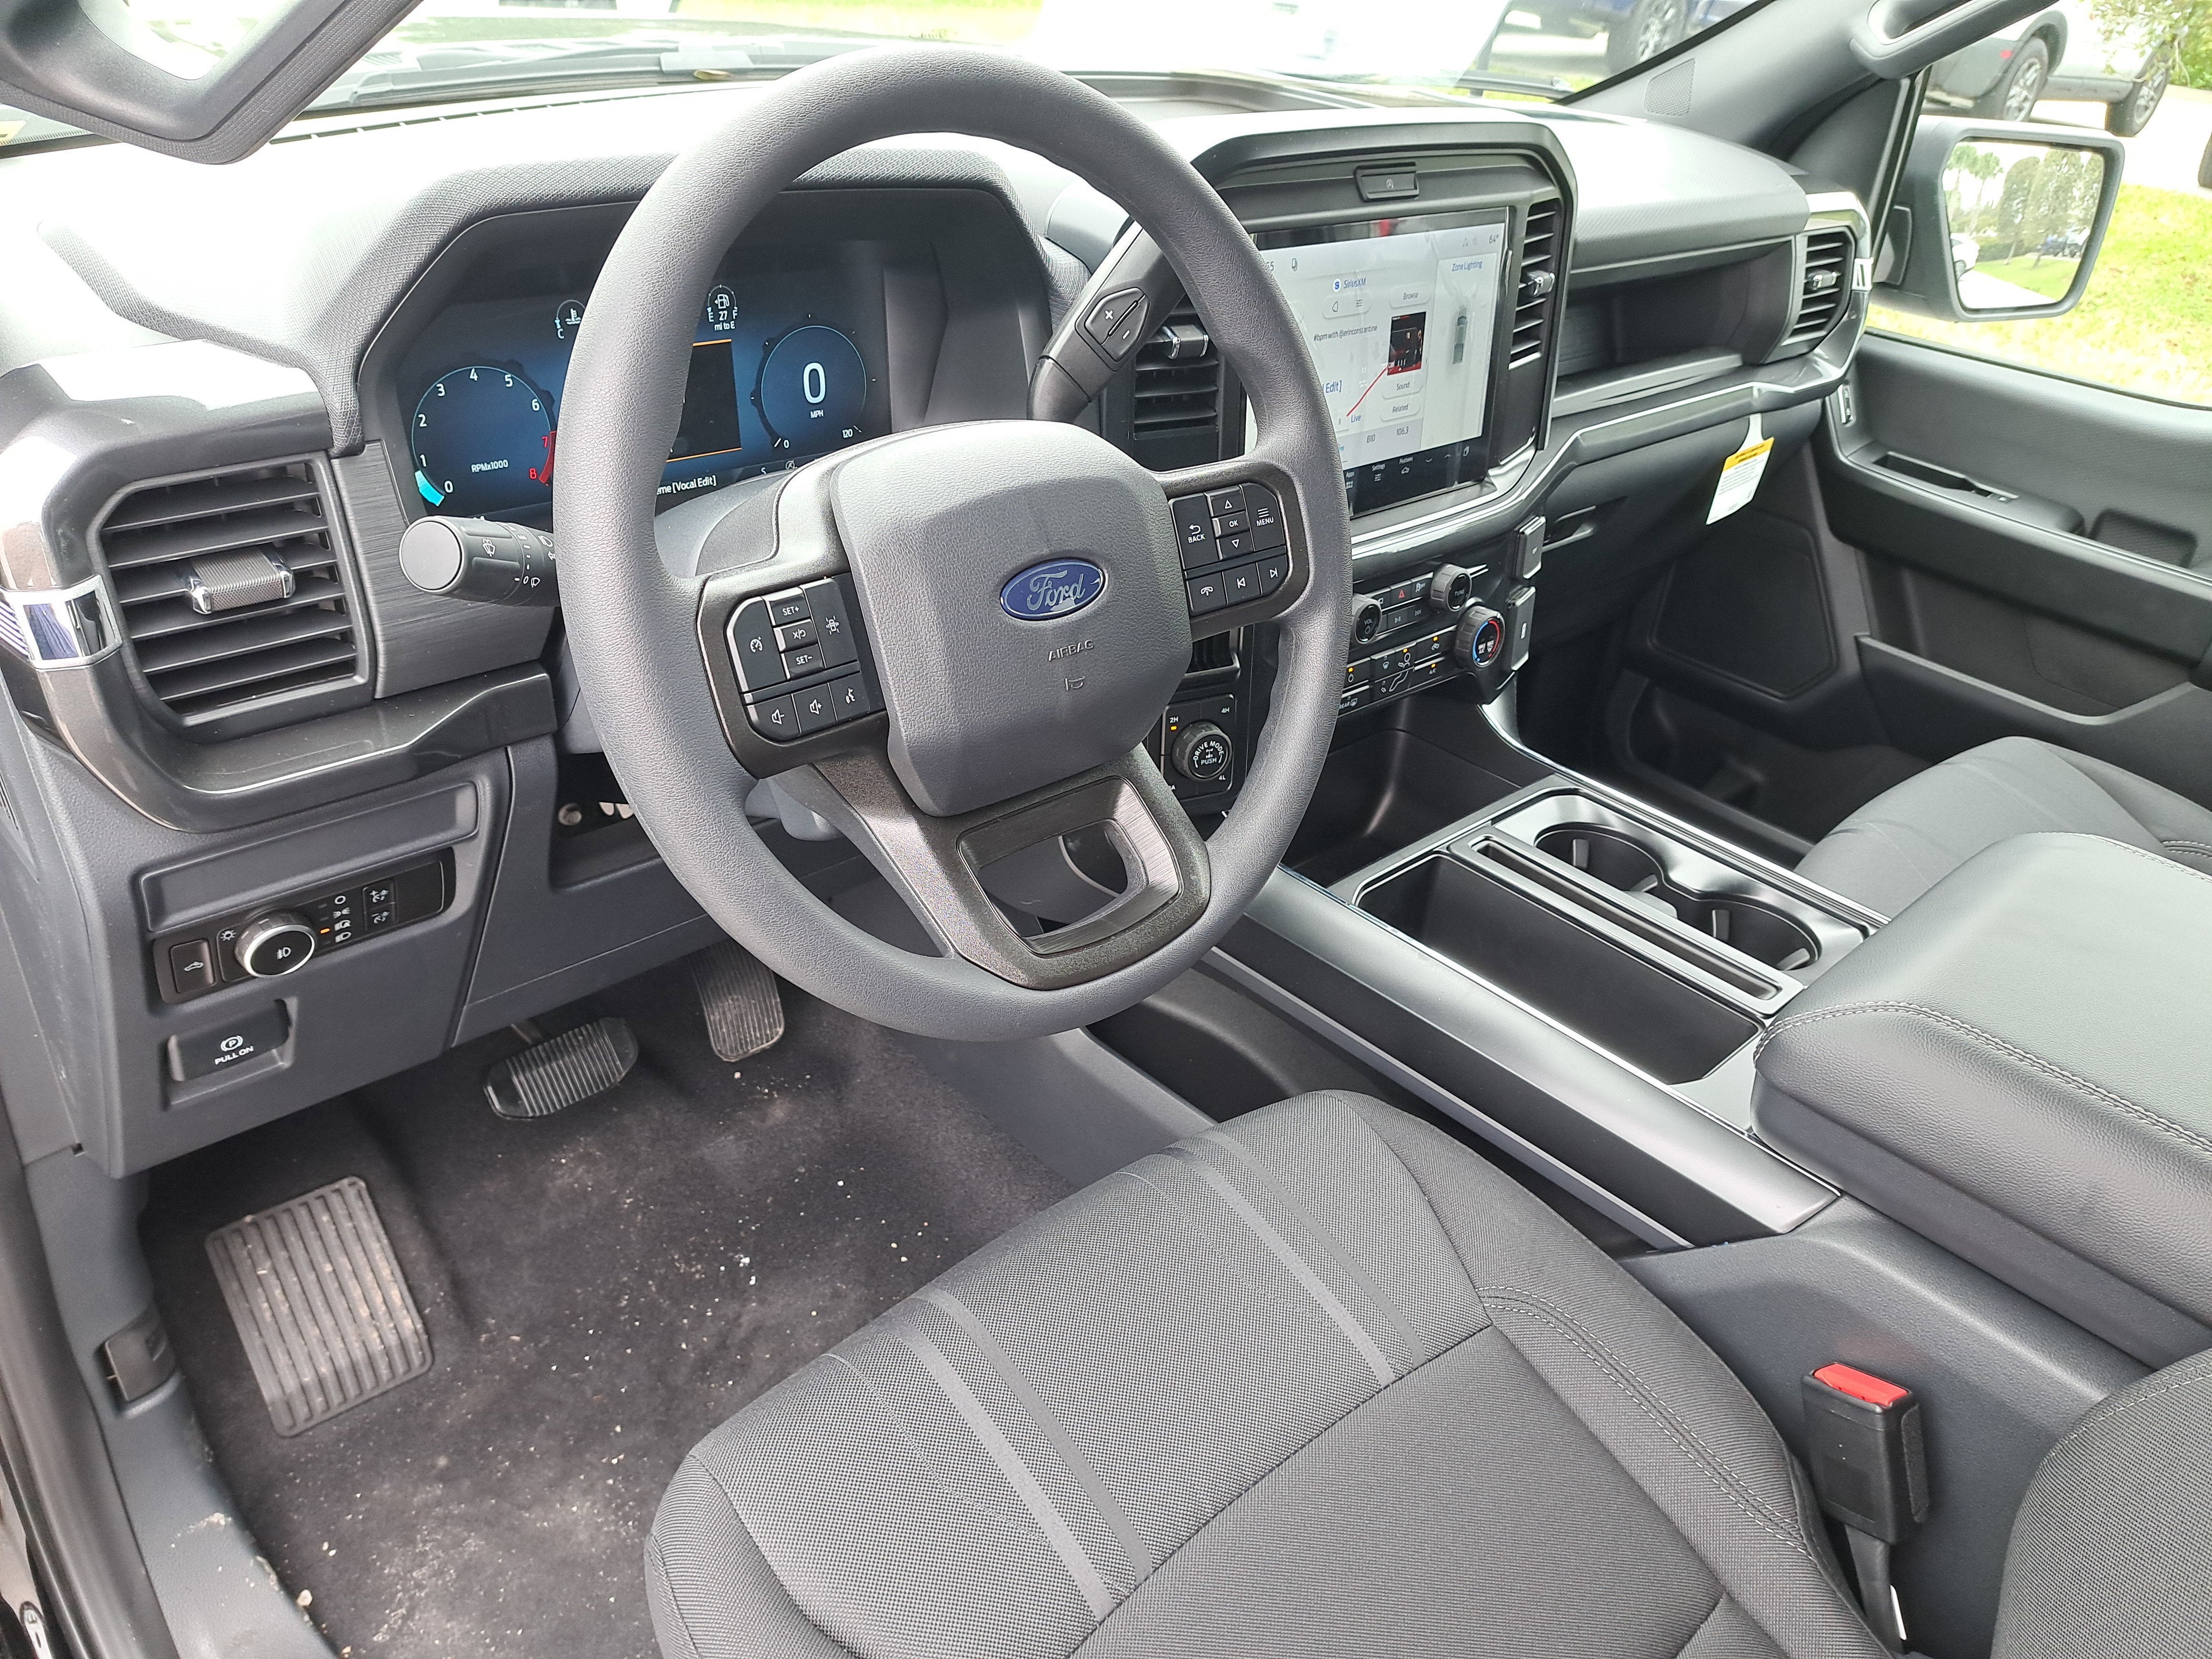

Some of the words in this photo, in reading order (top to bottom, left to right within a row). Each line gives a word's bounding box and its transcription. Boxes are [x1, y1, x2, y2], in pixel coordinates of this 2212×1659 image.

[1452, 264, 1463, 272] Zone
[1464, 261, 1482, 271] Lighting
[1343, 277, 1366, 289] SiriusXM
[708, 312, 714, 322] E
[719, 310, 727, 321] 27
[733, 310, 738, 320] F
[730, 321, 735, 329] E
[557, 328, 564, 339] C
[1328, 331, 1338, 339] with
[470, 368, 478, 381] 4
[505, 374, 513, 387] 5
[803, 362, 826, 404] 0
[1396, 382, 1410, 390] Sound
[436, 383, 445, 397] 3
[1326, 380, 1342, 393] Edit]
[531, 399, 540, 411] 6
[1393, 403, 1408, 413] Related
[810, 409, 824, 418] MPH
[1351, 414, 1361, 423] Live
[418, 414, 427, 427] 2
[842, 429, 853, 438] 120
[1396, 426, 1409, 436] 106.3
[542, 436, 548, 448] 7
[783, 439, 790, 449] 0
[420, 454, 426, 467] 1
[471, 459, 509, 473] RPMx1000
[529, 468, 537, 479] 8
[444, 480, 453, 493] 0
[672, 478, 697, 494] [Vocal
[697, 475, 717, 487] Edit]
[1229, 519, 1239, 528] OK
[1256, 516, 1274, 527] MENU
[1188, 533, 1205, 544] BACK
[1027, 570, 1086, 611] Ford
[782, 606, 799, 616] SET+
[1048, 640, 1094, 662] AIRBAG
[796, 655, 813, 665] SET-
[1193, 741, 1208, 761] DRIVE
[1209, 741, 1224, 756] MODE
[1201, 757, 1217, 765] PUSH
[214, 1052, 239, 1065] PULL
[239, 1045, 254, 1056] ON
